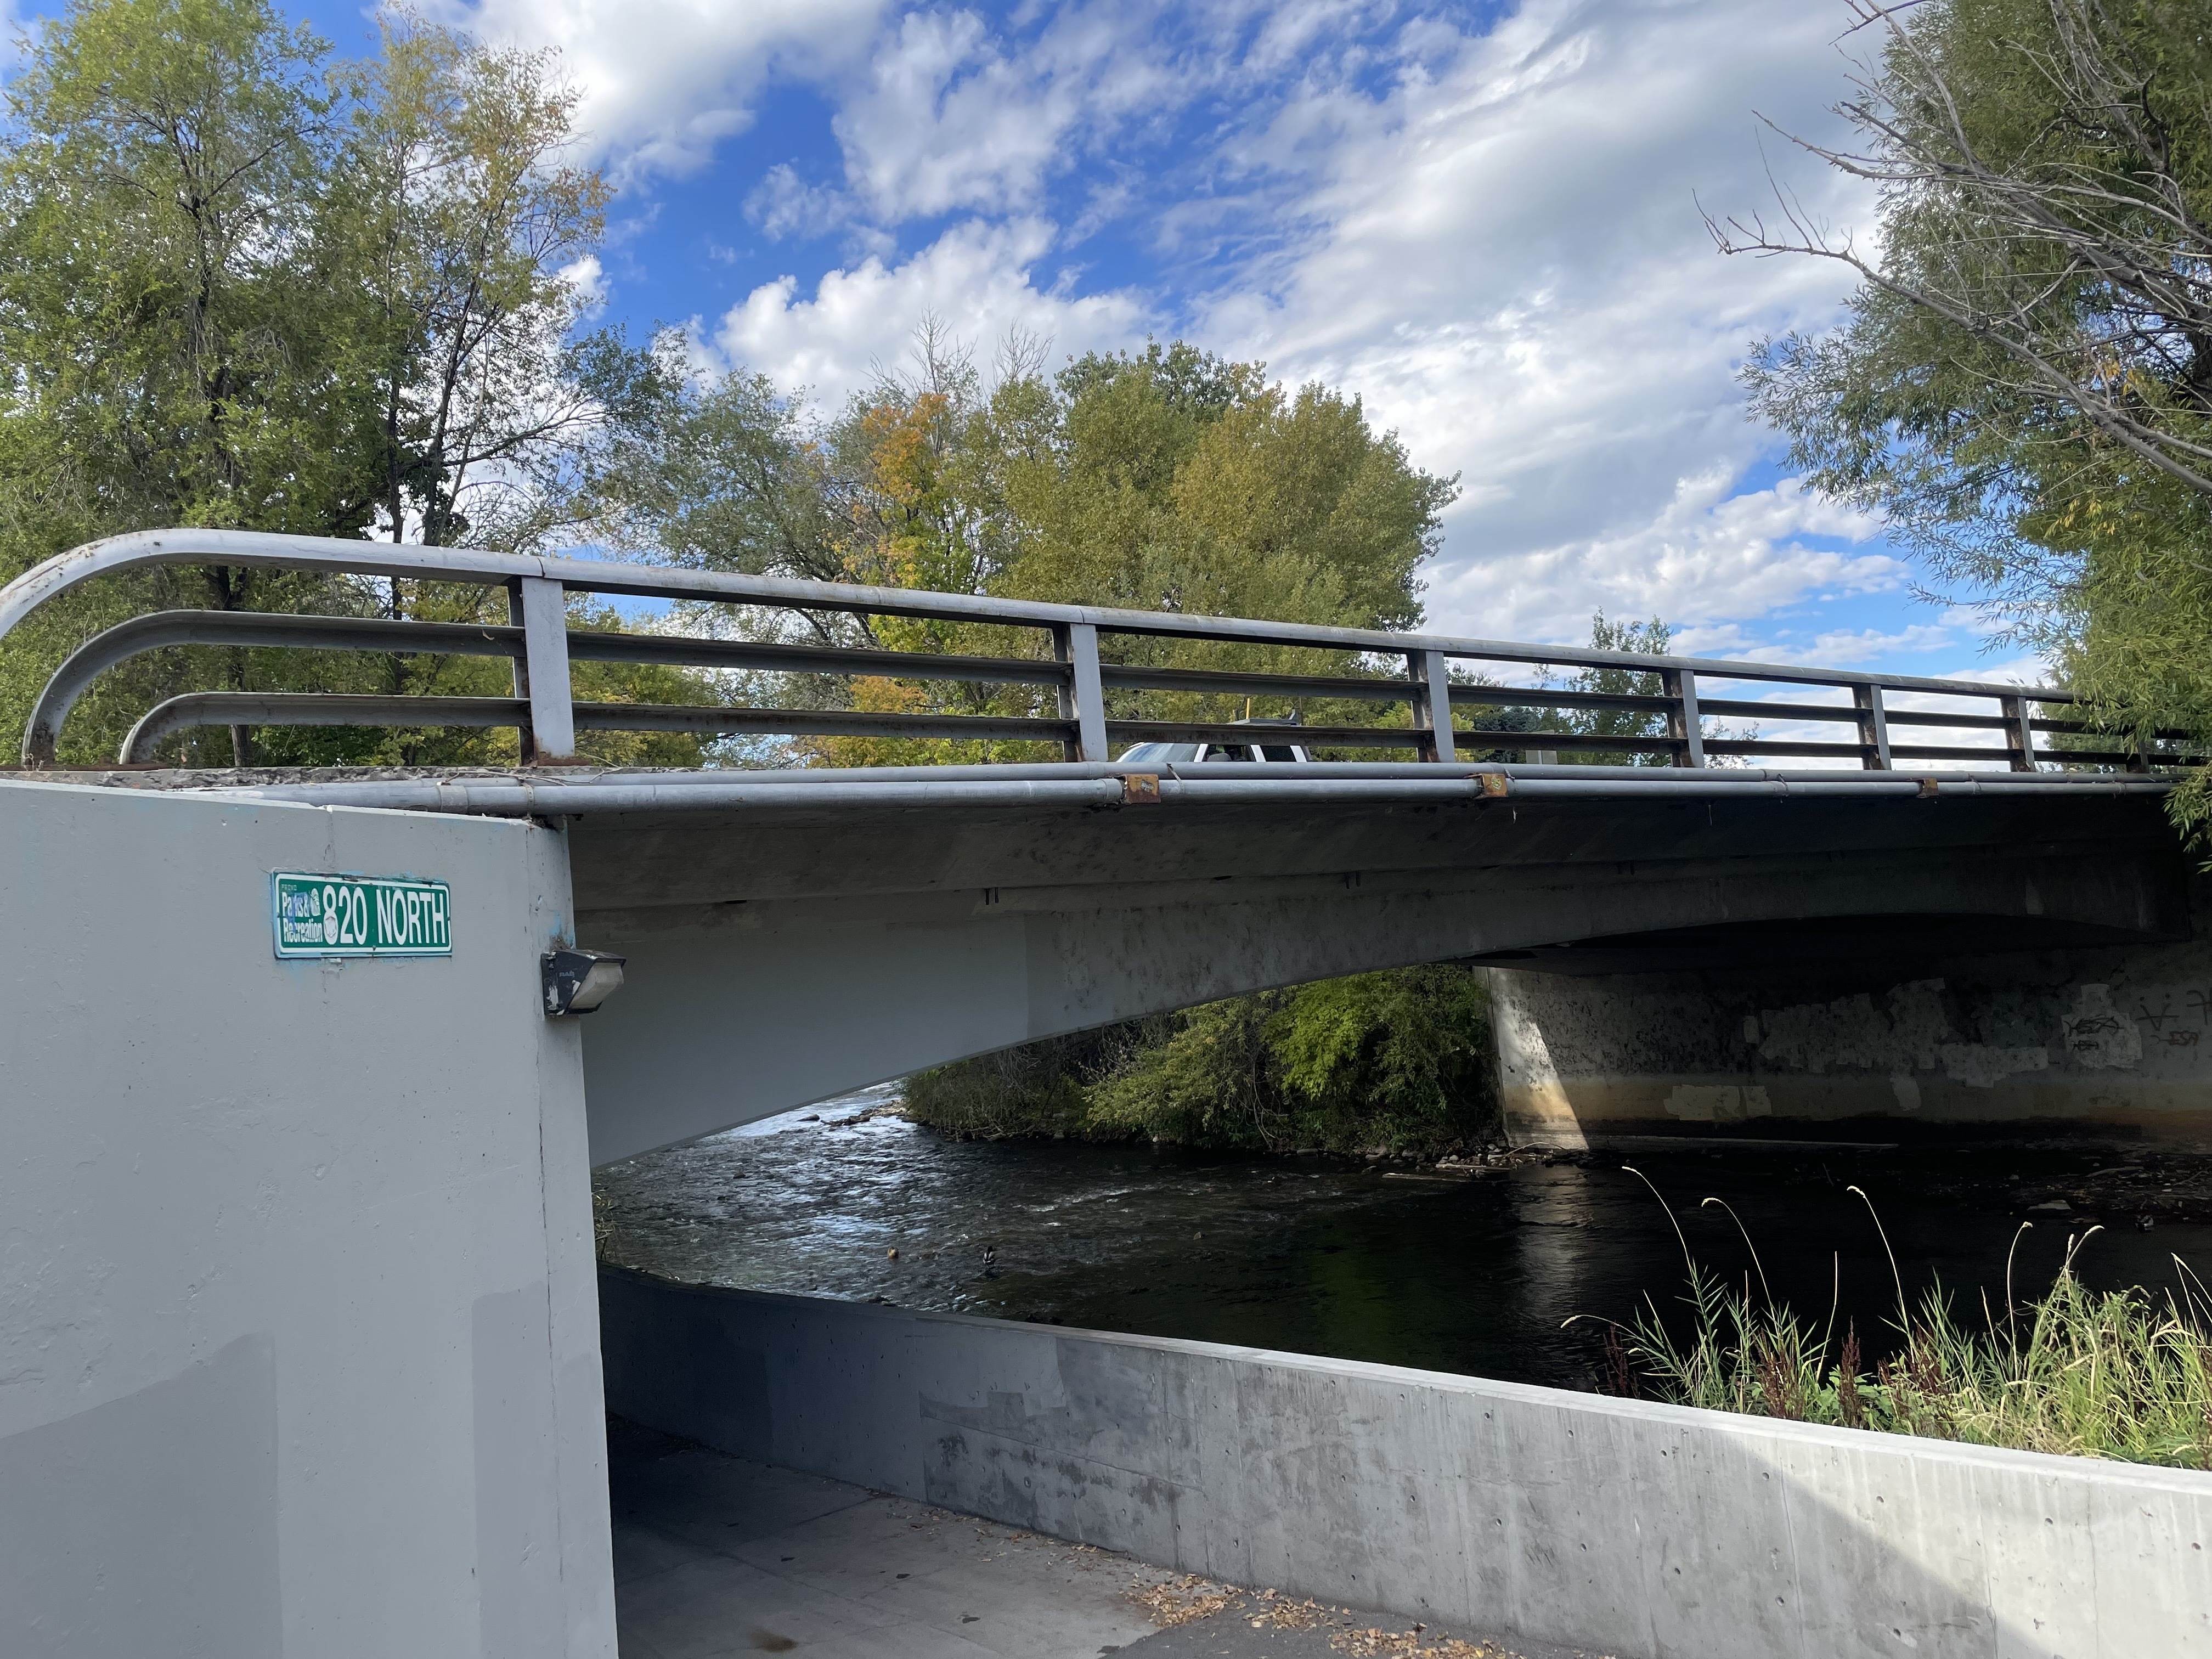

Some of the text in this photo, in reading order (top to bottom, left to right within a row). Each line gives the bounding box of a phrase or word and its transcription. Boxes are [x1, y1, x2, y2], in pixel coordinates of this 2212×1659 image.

[283, 917, 323, 943] Recreation
[323, 885, 446, 945] 820 NORTH
